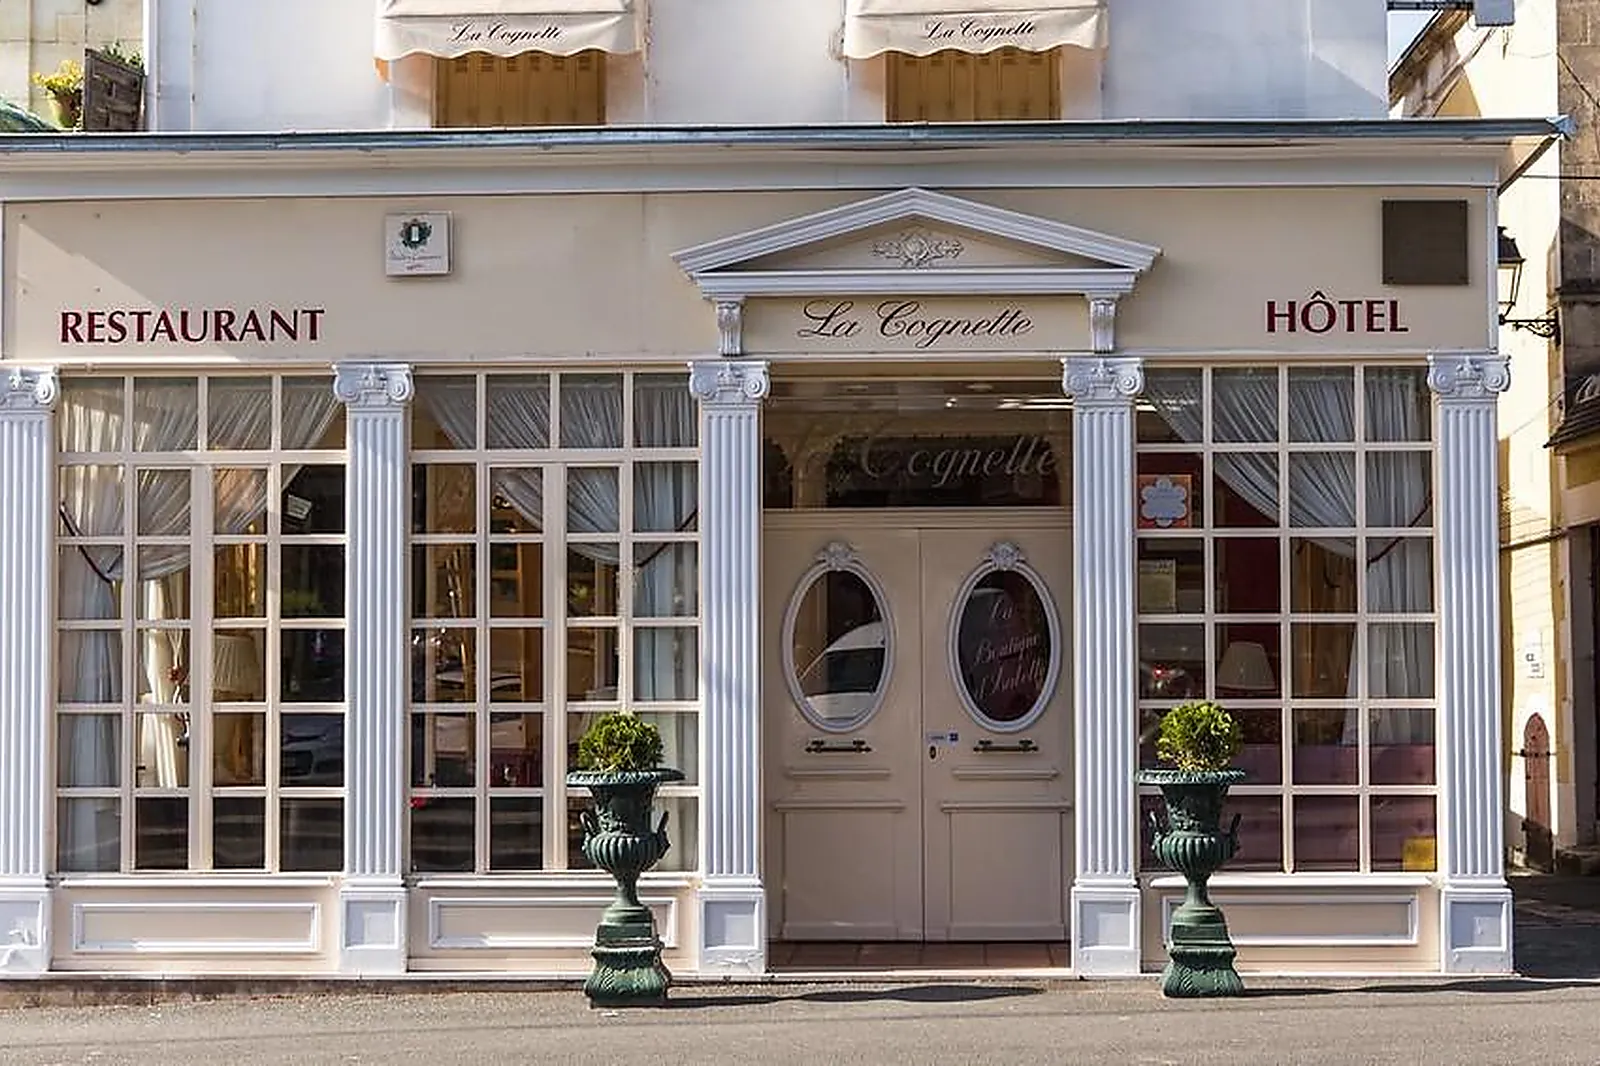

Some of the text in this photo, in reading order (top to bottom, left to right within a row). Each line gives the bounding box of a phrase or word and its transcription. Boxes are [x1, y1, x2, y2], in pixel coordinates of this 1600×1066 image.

[449, 21, 563, 46] La Cognette
[925, 17, 1037, 43] La Cognette
[60, 308, 326, 344] RESTAURANT
[798, 300, 1036, 349] La Cognette
[1266, 291, 1409, 333] HÔTEL
